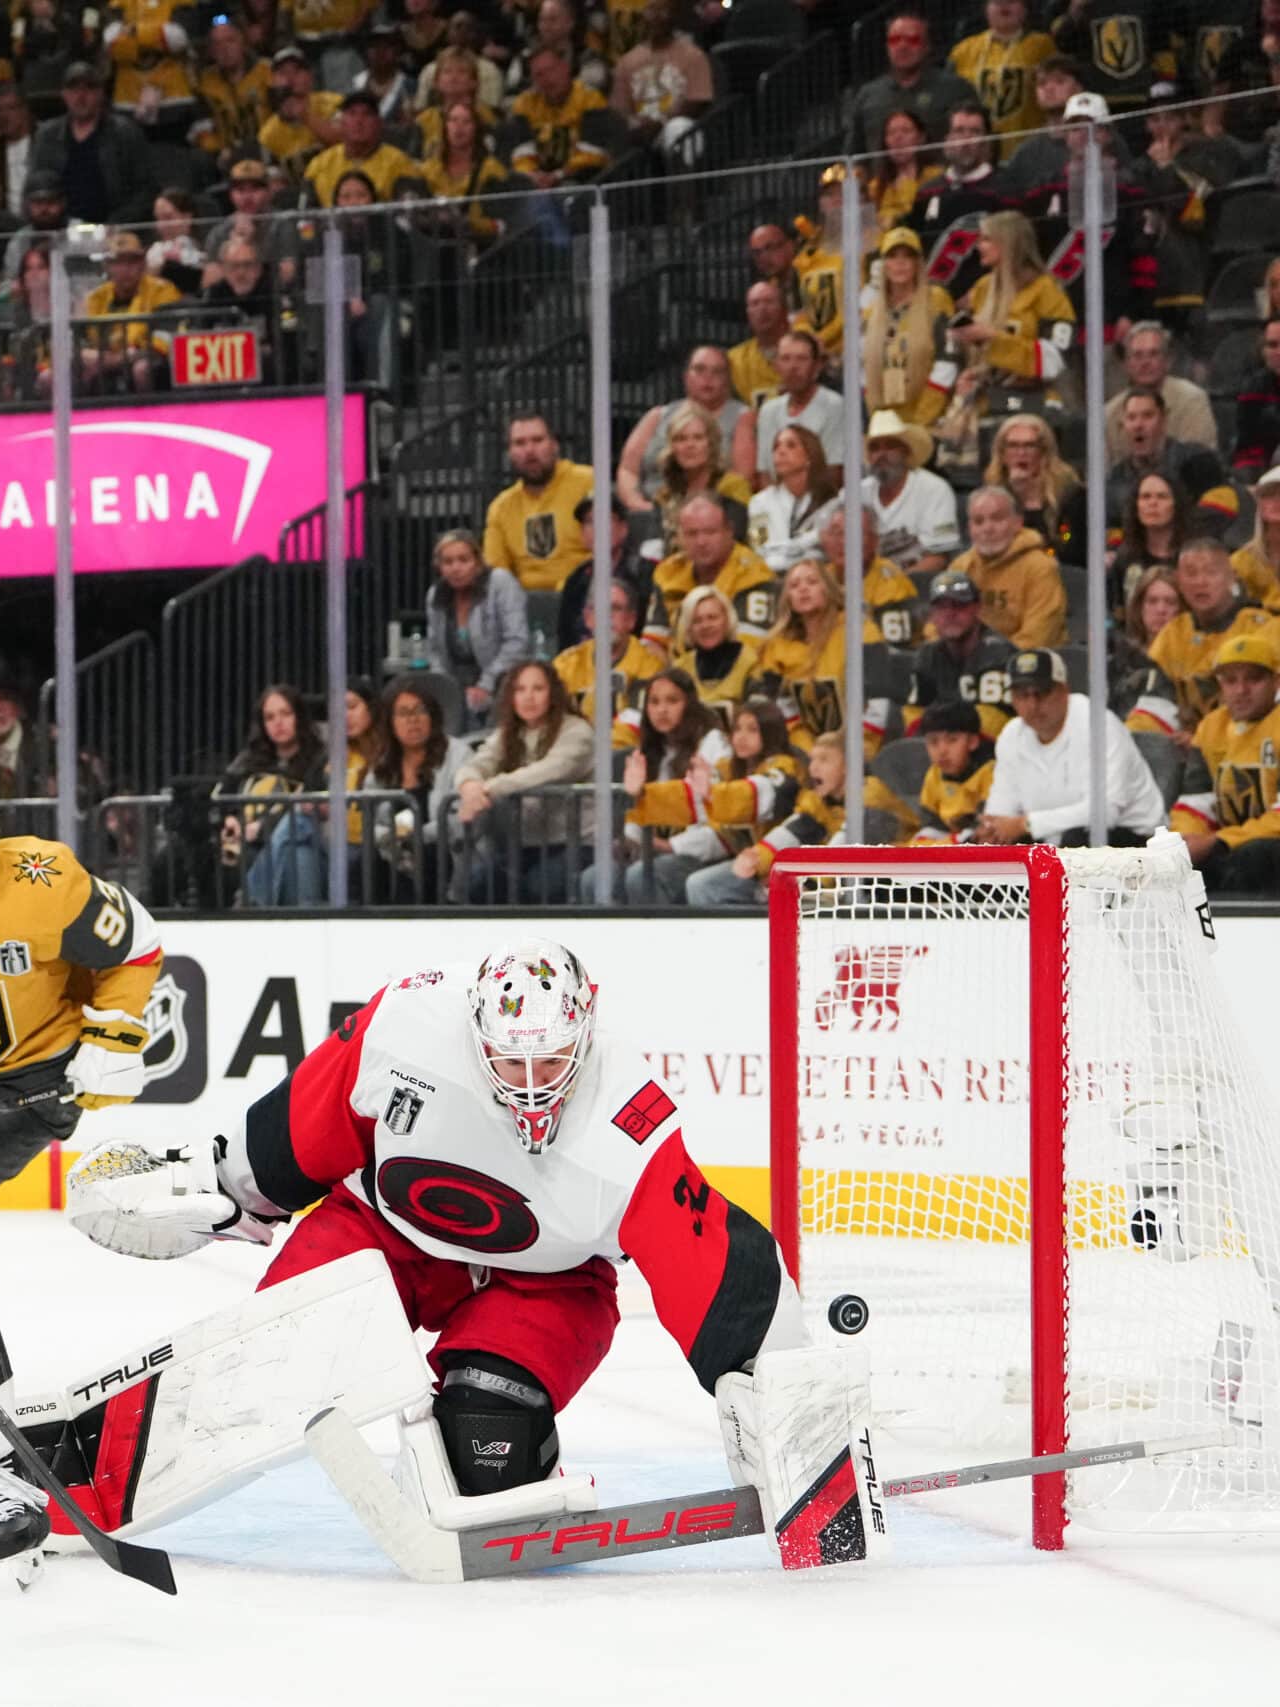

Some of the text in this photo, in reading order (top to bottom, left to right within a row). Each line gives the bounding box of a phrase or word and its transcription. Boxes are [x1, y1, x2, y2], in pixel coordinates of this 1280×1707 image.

[187, 333, 246, 384] EXIT
[882, 610, 912, 642] 61
[960, 675, 976, 700] C
[390, 1069, 436, 1094] NUCOR
[73, 1343, 174, 1402] TRUE
[858, 1427, 886, 1536] TRUE
[481, 1501, 738, 1562] TRUE
